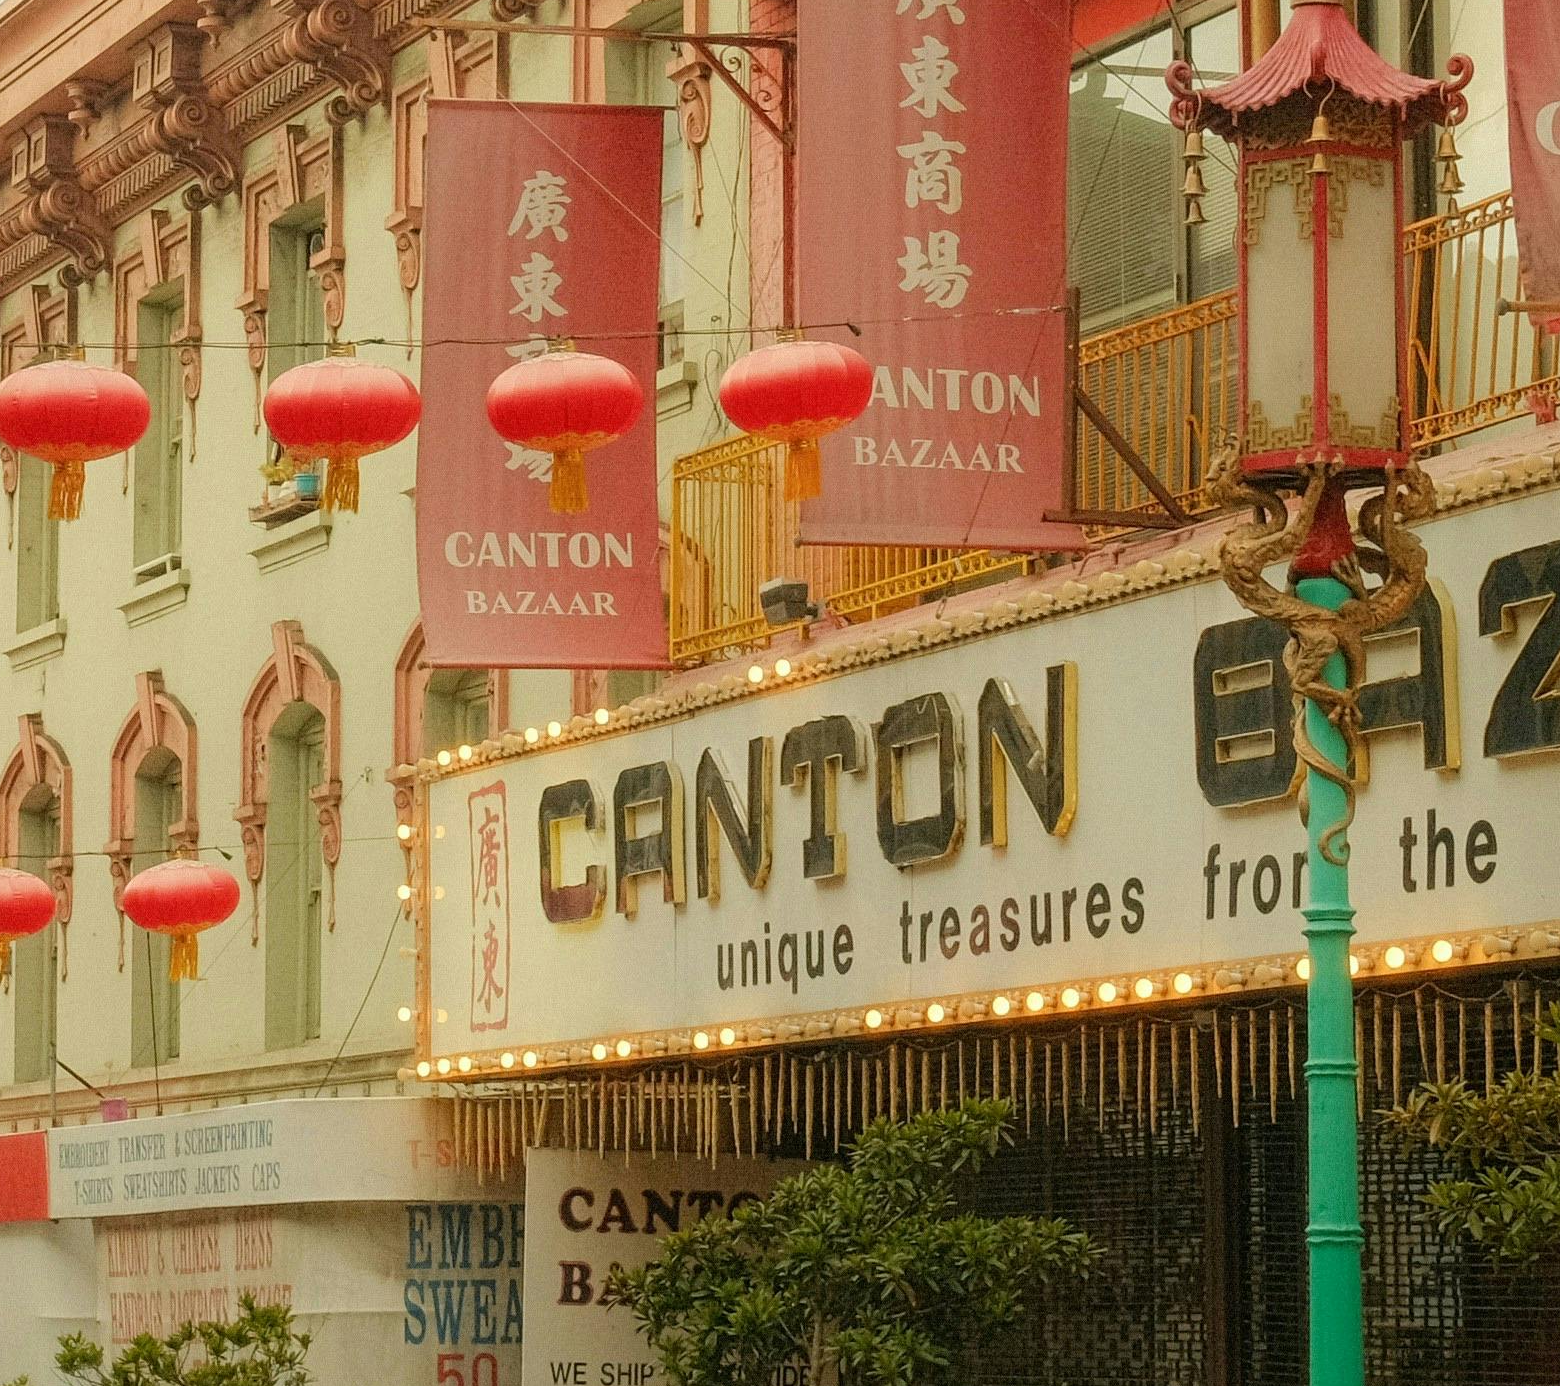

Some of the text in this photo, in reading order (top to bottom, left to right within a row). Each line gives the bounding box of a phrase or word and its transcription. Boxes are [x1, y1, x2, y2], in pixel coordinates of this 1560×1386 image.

[866, 365, 1042, 419] ANTON
[851, 434, 1025, 475] BAZAAR
[444, 529, 634, 570] CANTON
[464, 589, 619, 617] BAZAAR
[538, 662, 1078, 925] CANTON
[474, 803, 505, 1014] 廣東
[716, 921, 855, 994] unique
[899, 876, 1146, 966] treasures
[1399, 807, 1498, 895] the
[118, 1132, 167, 1163] TRANSFER
[123, 1169, 188, 1201] SWEATSHIRTS
[252, 1161, 280, 1192] CAPS
[551, 1362, 587, 1385] WE
